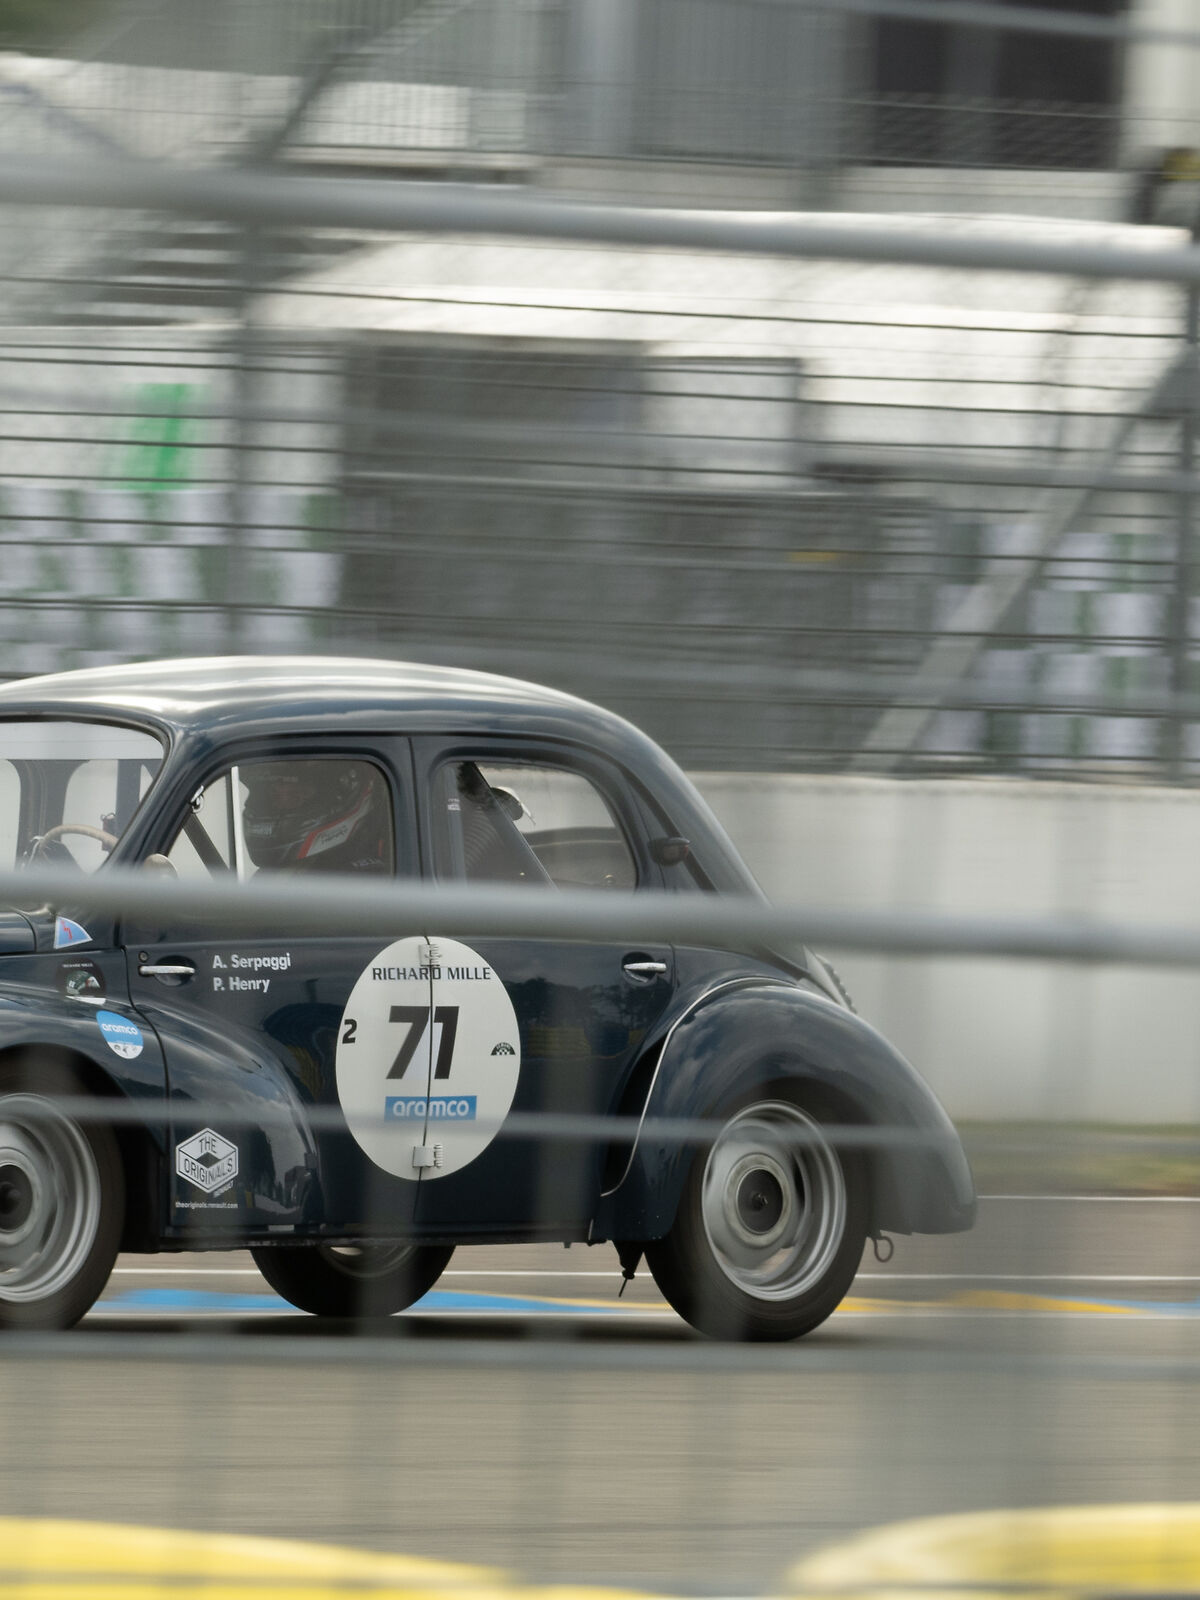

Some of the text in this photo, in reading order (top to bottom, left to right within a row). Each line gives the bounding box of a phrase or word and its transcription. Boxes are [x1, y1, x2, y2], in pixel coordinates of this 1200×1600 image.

[212, 952, 291, 971] A. Serpaggi
[372, 967, 491, 981] RICHARD MILLE
[213, 976, 270, 993] P. Henry
[101, 1023, 139, 1035] aramco
[341, 1018, 358, 1044] 2
[385, 1005, 460, 1080] 71
[392, 1099, 470, 1118] aramco
[199, 1136, 217, 1154] THE
